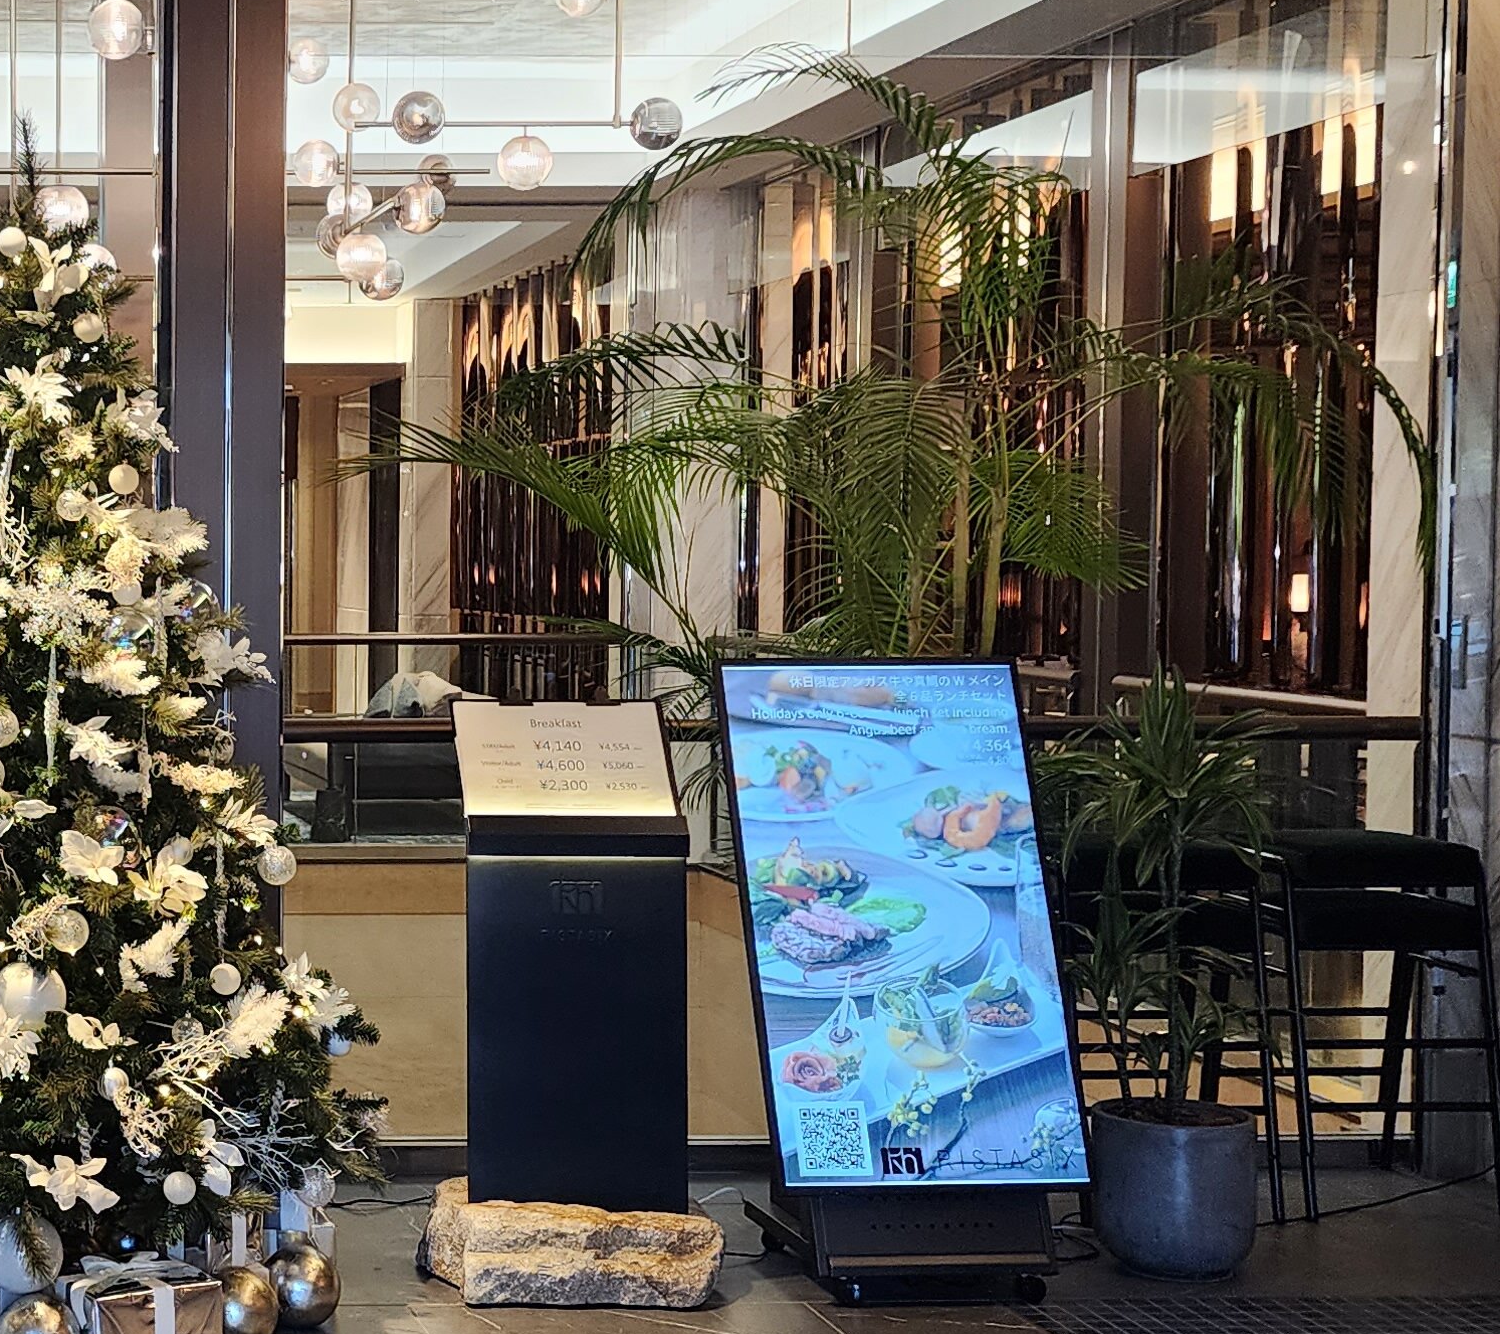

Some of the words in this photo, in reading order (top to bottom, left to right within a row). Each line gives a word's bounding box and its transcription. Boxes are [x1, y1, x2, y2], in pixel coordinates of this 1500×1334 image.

[751, 708, 805, 721] Holidays
[530, 718, 582, 729] Breakfast
[890, 724, 917, 735] beef
[533, 740, 582, 753] ¥4,140
[536, 759, 585, 772] ¥4,600
[540, 779, 588, 792] ¥2,300
[937, 1147, 1078, 1171] RISTASIX
